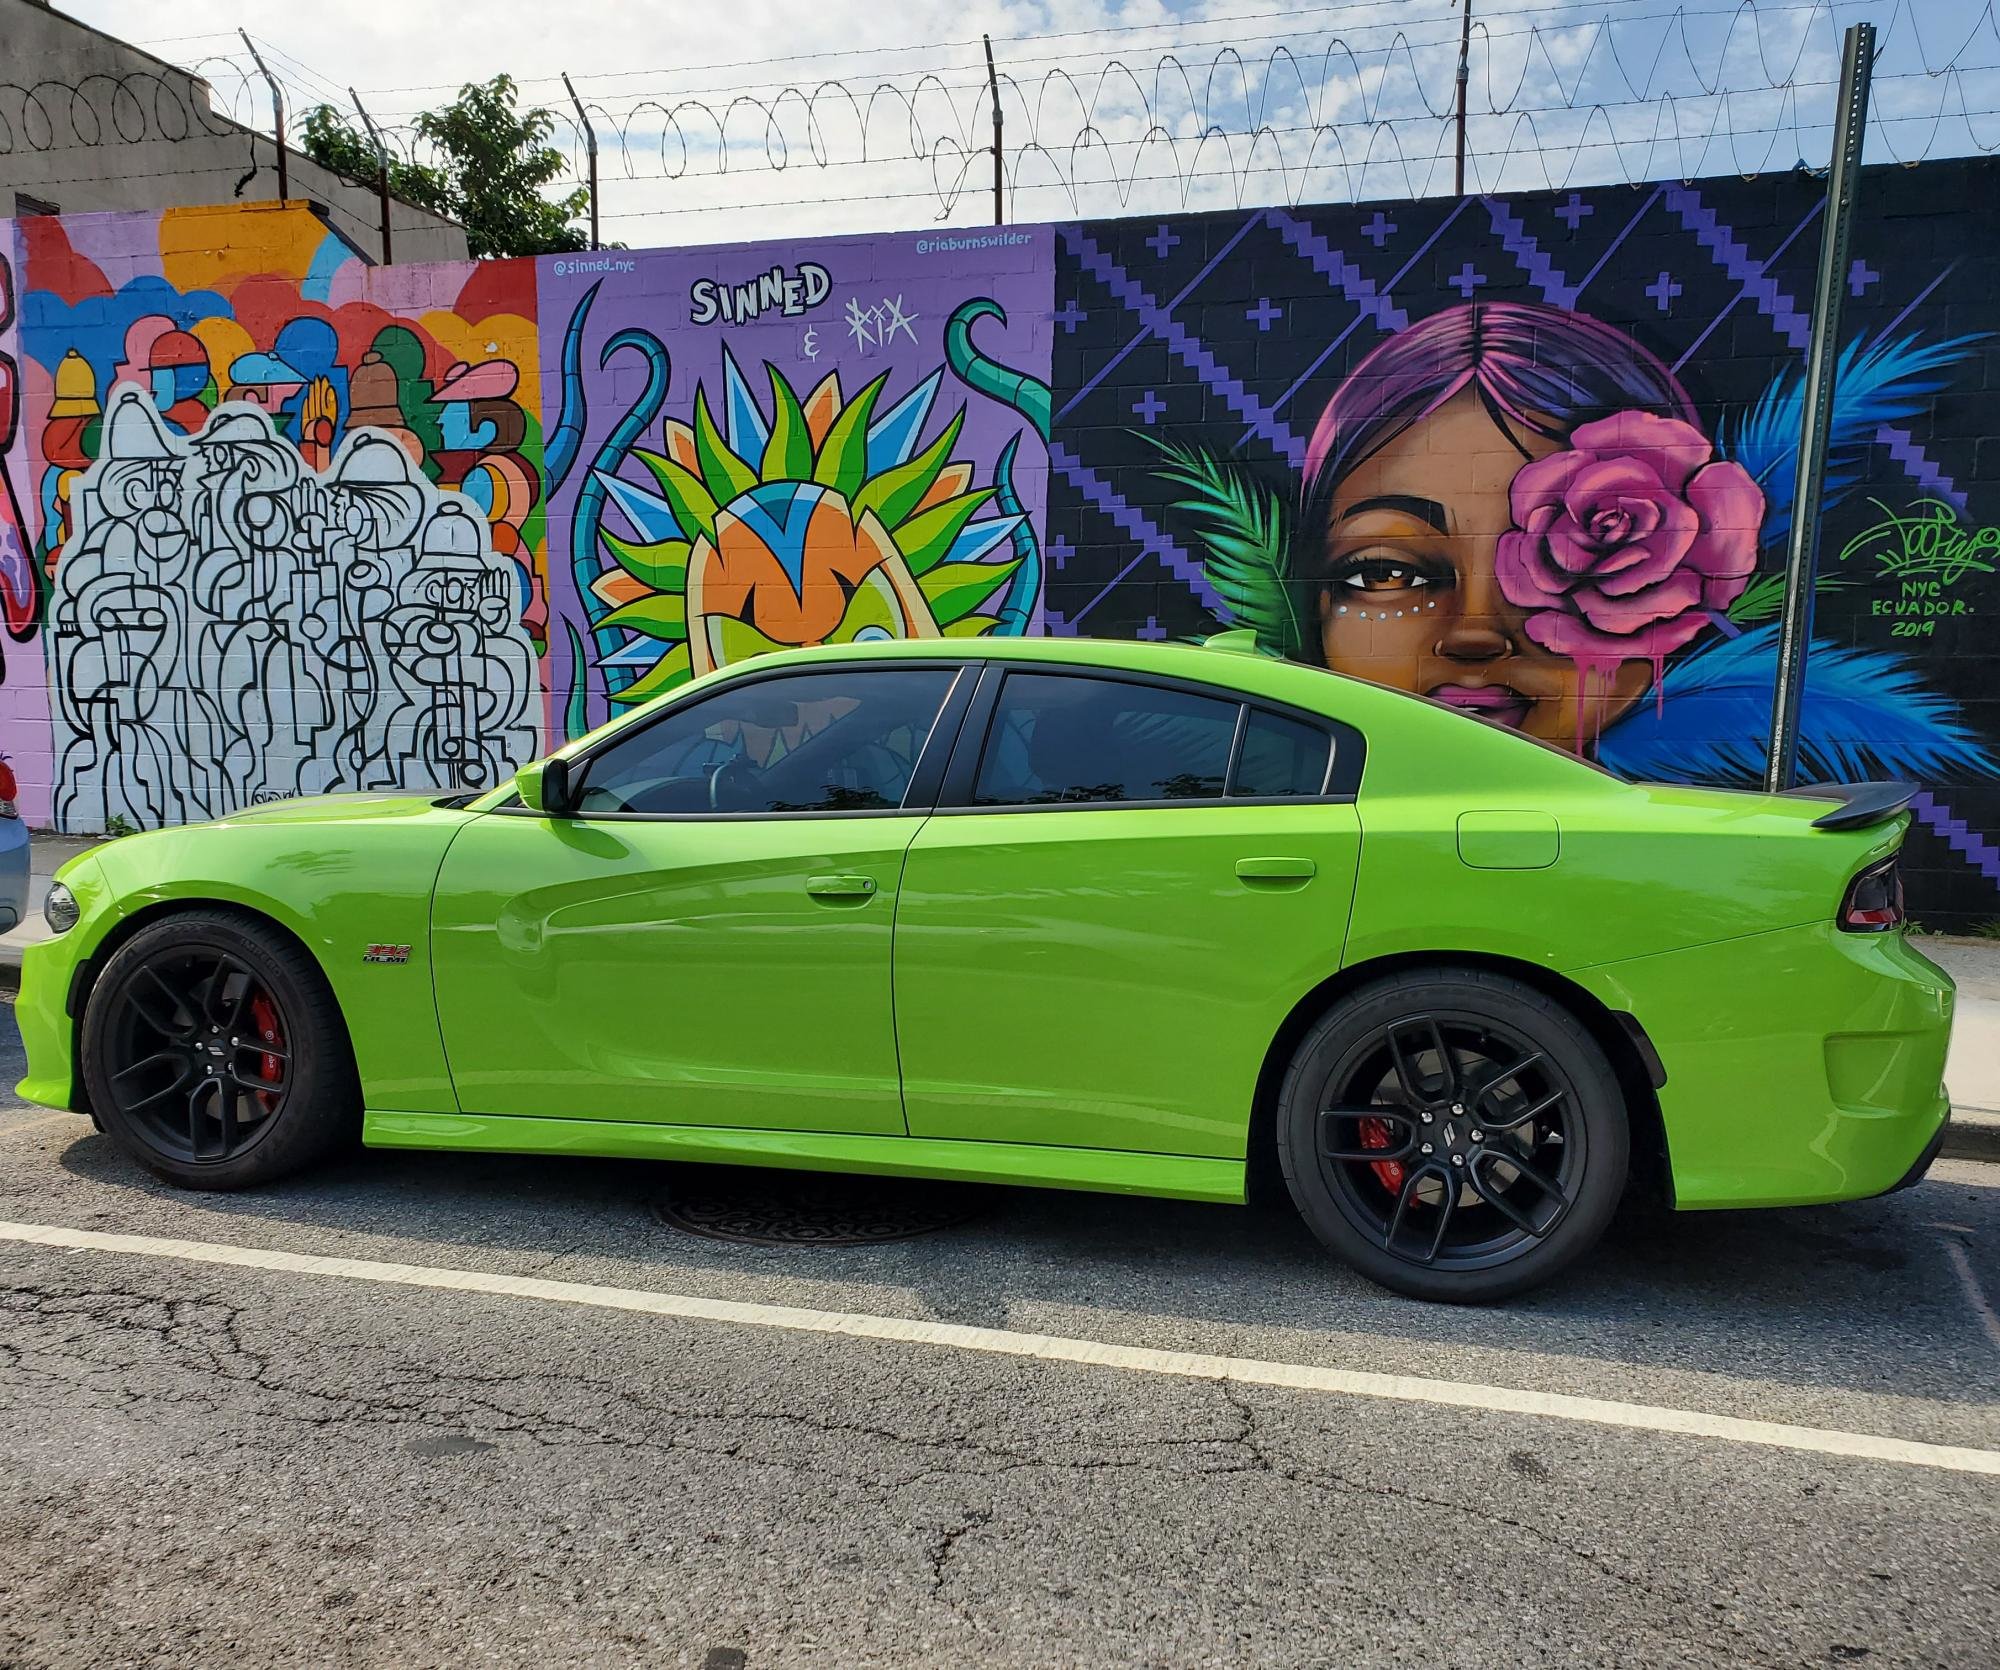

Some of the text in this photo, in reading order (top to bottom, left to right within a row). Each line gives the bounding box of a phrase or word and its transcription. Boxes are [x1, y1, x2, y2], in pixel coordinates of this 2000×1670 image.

[916, 233, 1032, 254] @riaburnswilder
[553, 257, 635, 276] @sinned_nyc
[690, 262, 832, 326] SINNED
[1902, 581, 1941, 597] NYC
[1891, 620, 1936, 636] 2019
